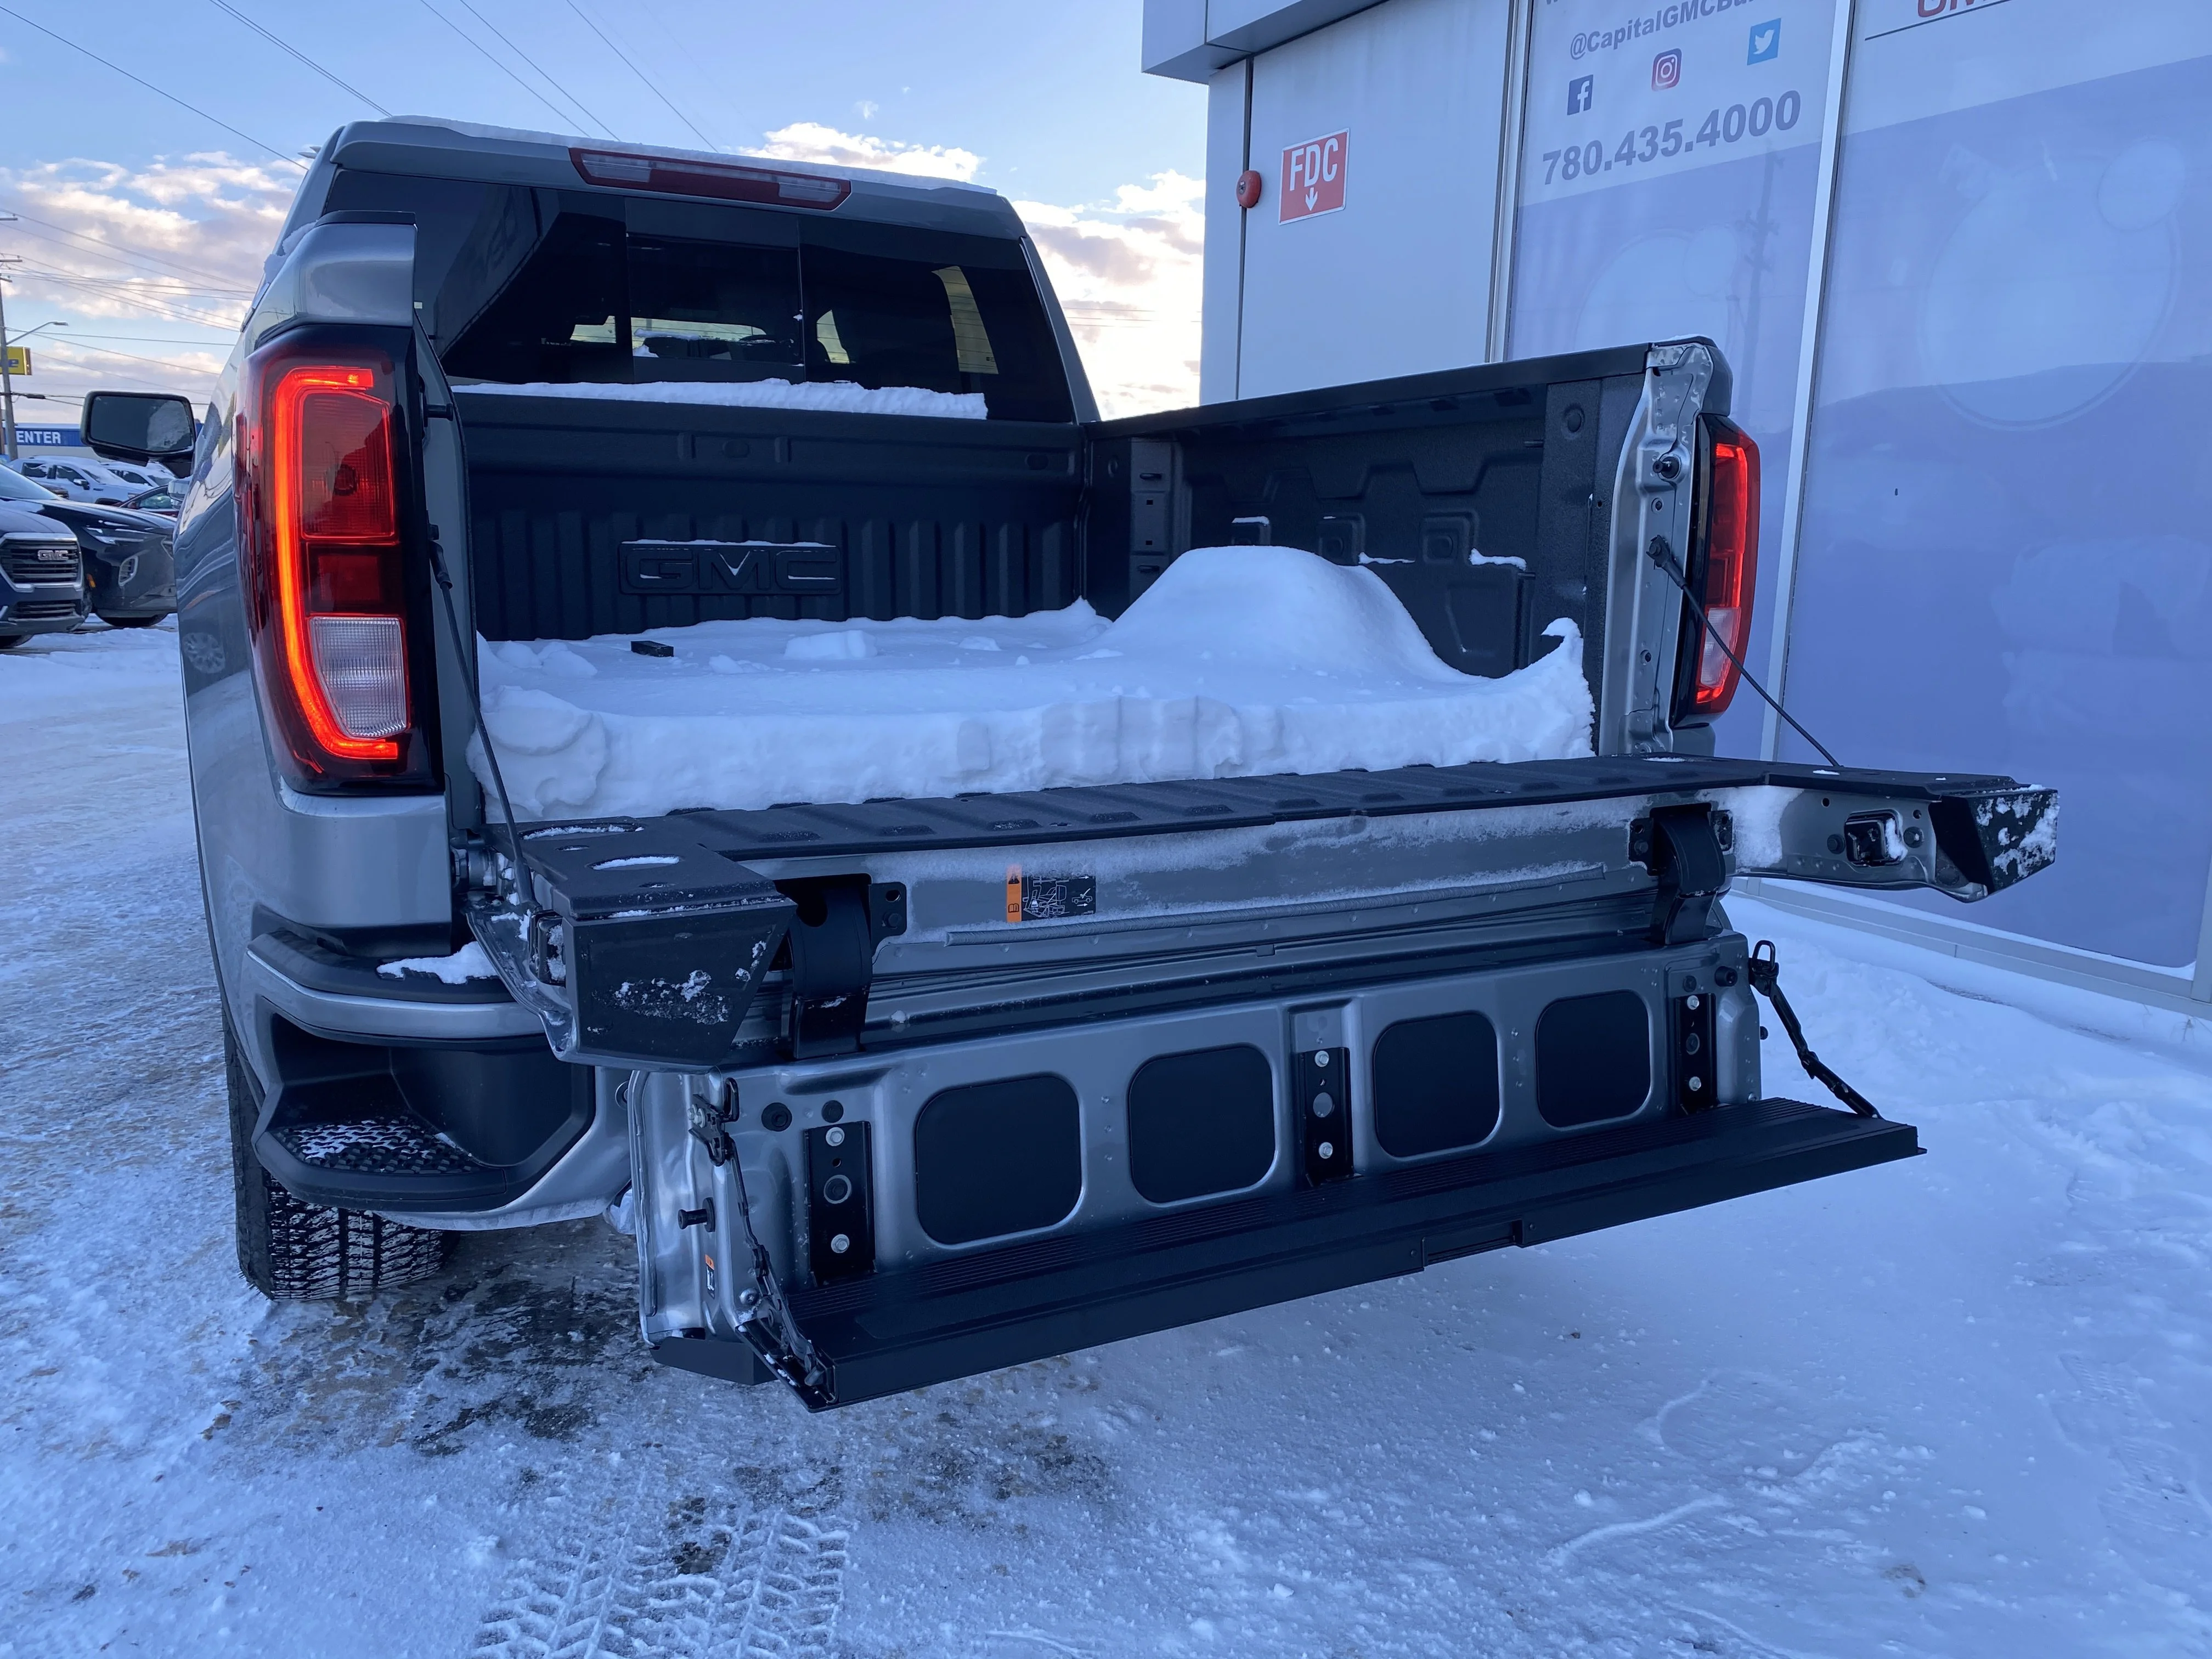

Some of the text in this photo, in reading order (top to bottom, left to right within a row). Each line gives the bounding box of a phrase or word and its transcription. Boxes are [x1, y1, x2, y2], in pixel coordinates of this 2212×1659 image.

[1570, 0, 1754, 60] @CapitalGMCB
[1542, 90, 1801, 185] 780.435.4000
[1289, 137, 1339, 191] FDC
[16, 431, 61, 444] ENTER
[37, 550, 69, 561] GMC
[626, 549, 838, 590] GMC
